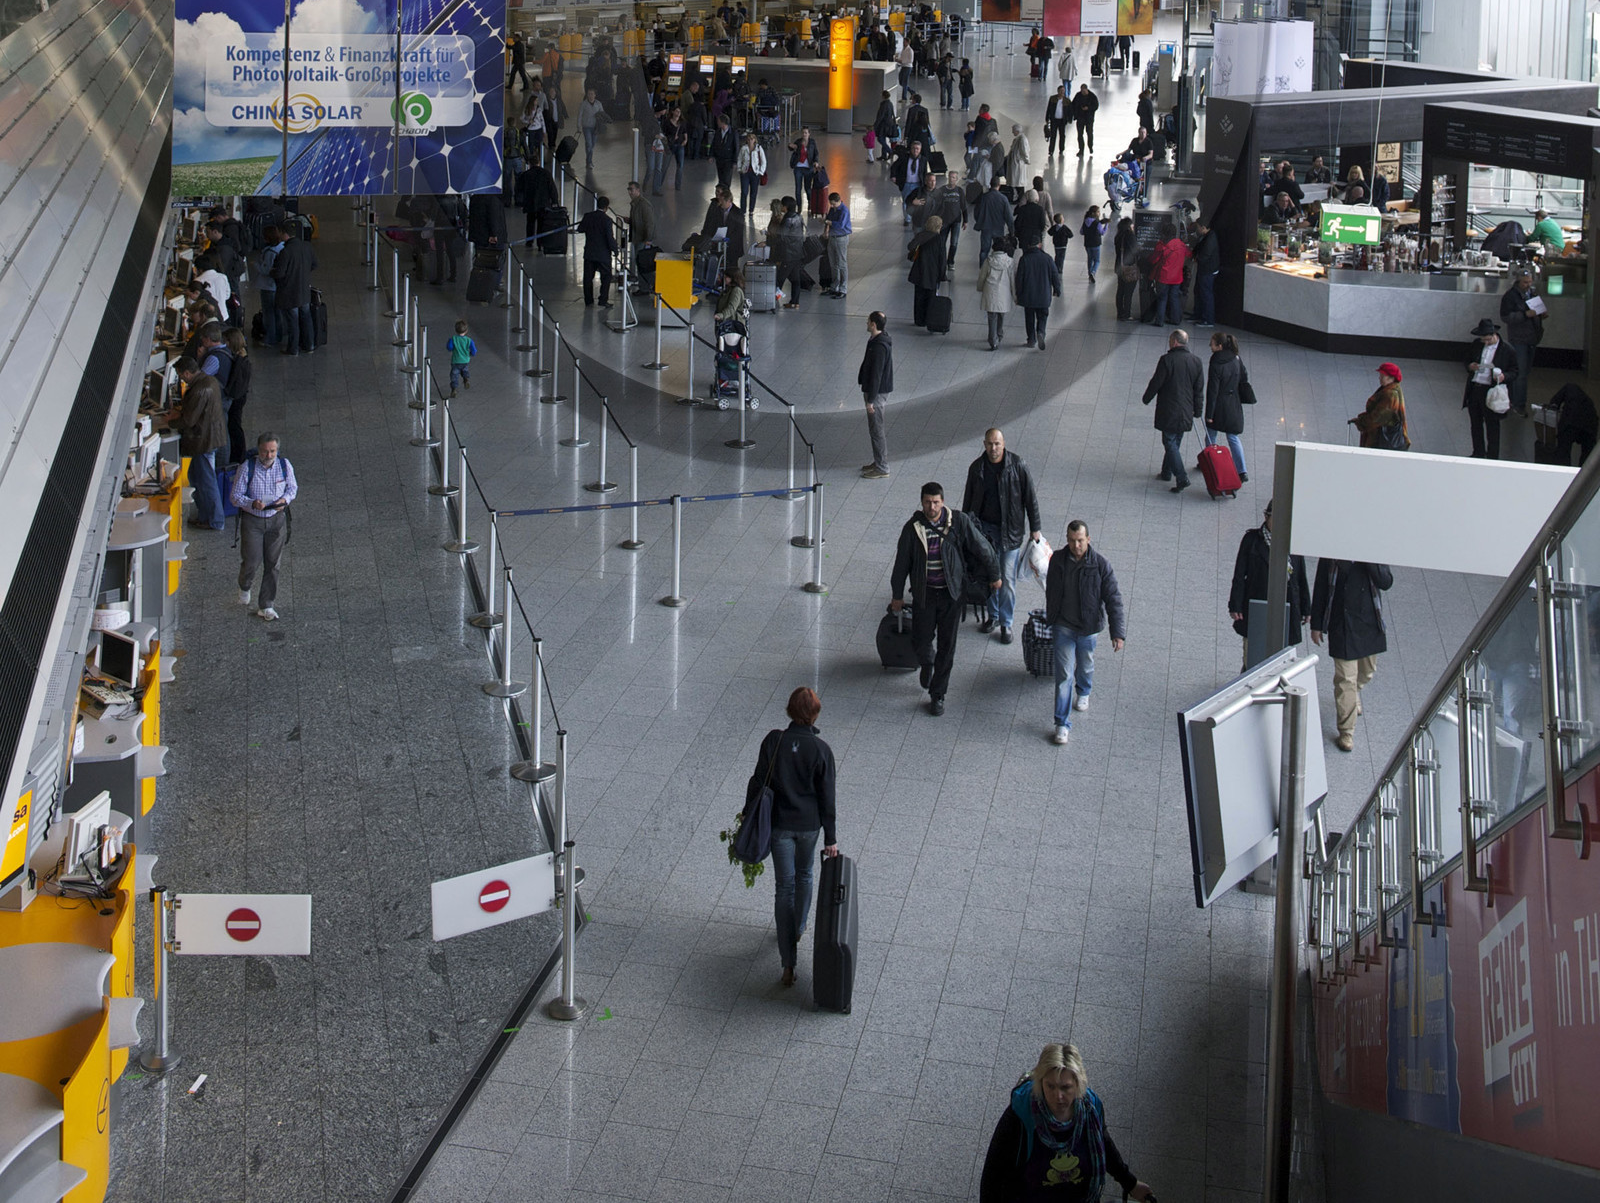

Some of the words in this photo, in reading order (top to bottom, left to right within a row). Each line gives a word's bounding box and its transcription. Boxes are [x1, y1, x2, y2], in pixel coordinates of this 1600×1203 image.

[324, 46, 335, 62] &
[339, 46, 432, 63] Finanzkraft
[436, 47, 455, 63] für
[232, 105, 296, 120] CHINA
[301, 105, 363, 120] SOLAR
[1480, 920, 1531, 1051] REWE
[1552, 923, 1573, 1028] in
[1511, 1040, 1537, 1107] CITY
